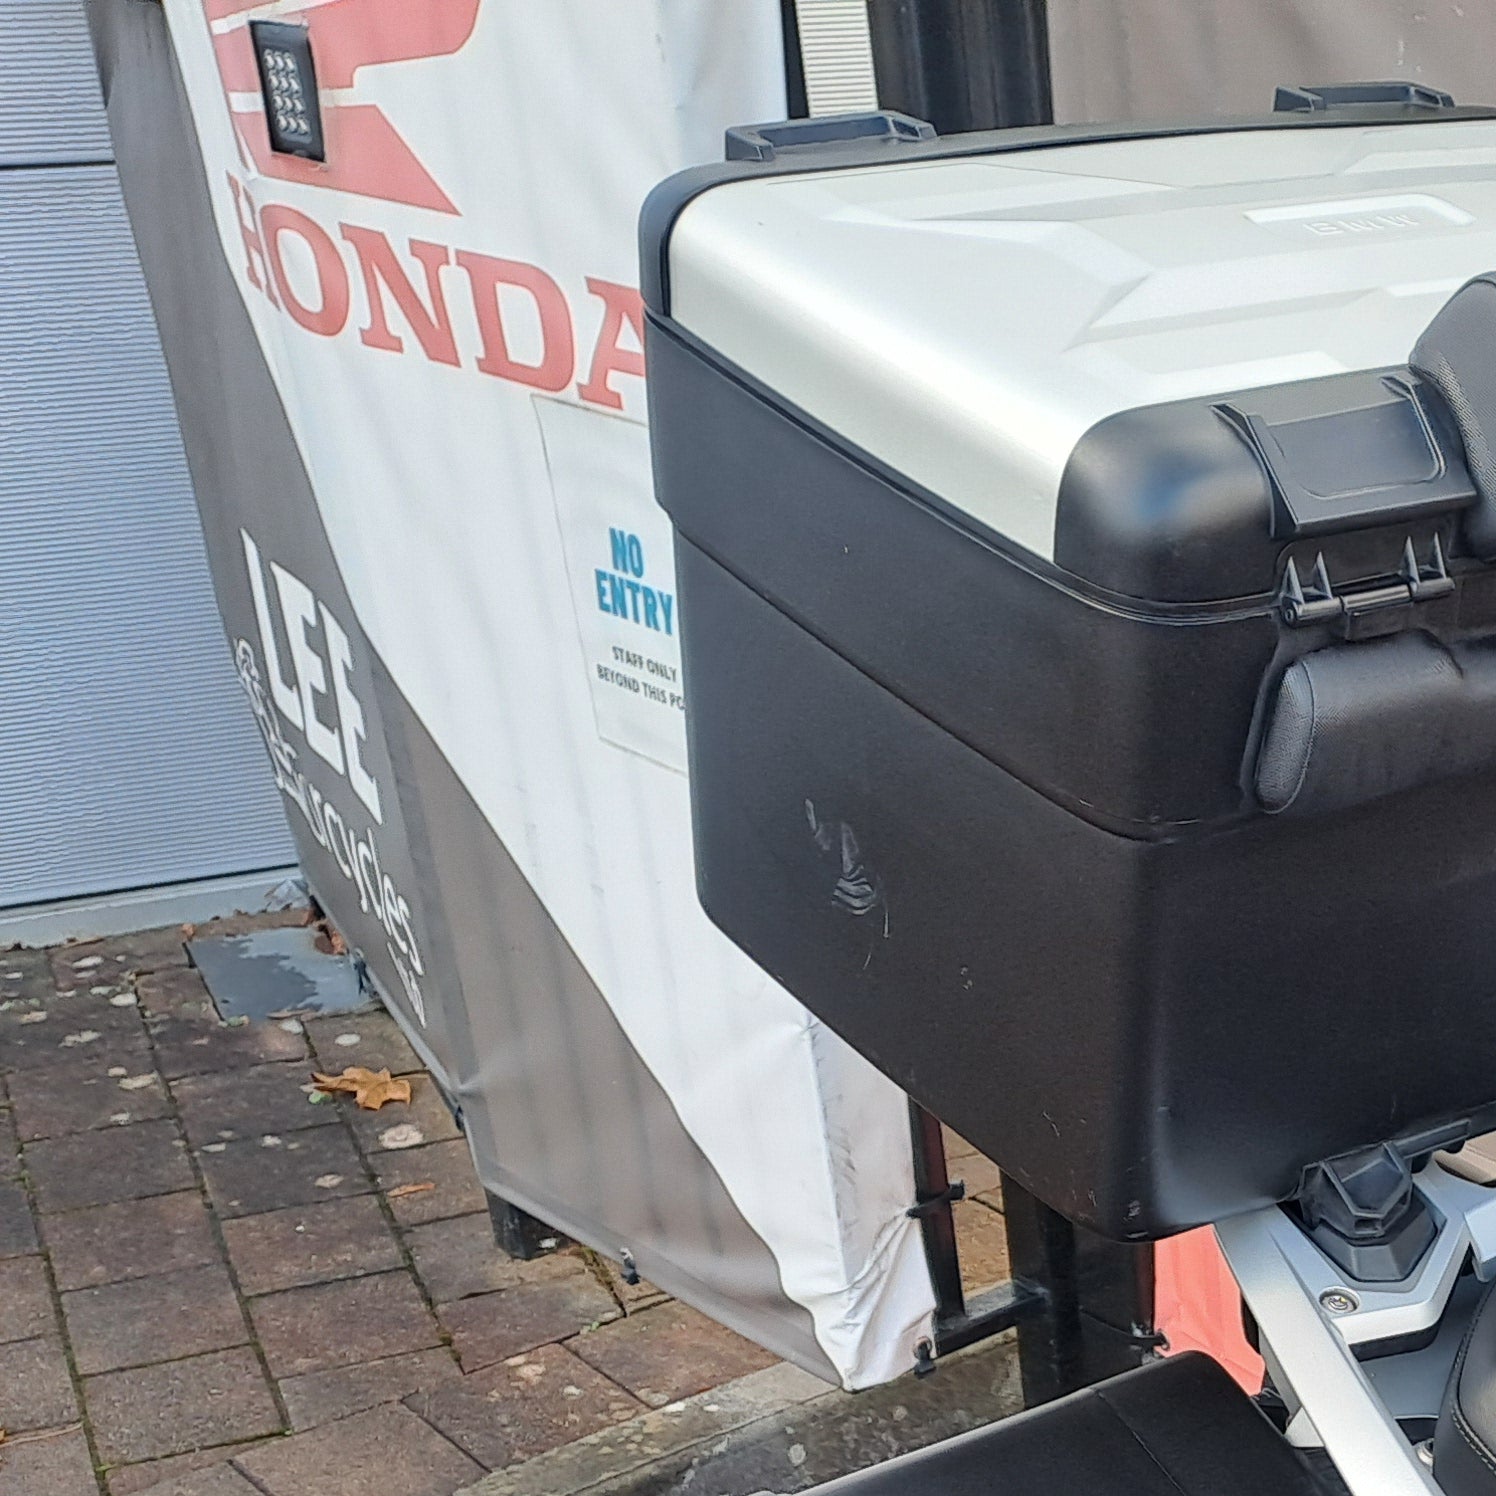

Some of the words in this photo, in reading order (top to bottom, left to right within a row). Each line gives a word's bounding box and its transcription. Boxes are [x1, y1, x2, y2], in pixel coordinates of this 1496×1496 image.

[226, 170, 645, 411] HONDA
[609, 527, 645, 578] NO
[594, 568, 673, 635] ENTRY
[239, 526, 381, 826] LEE
[597, 664, 641, 694] BEYOND
[641, 681, 668, 704] THIS
[612, 646, 644, 670] STAFF
[646, 658, 678, 683] ONLY
